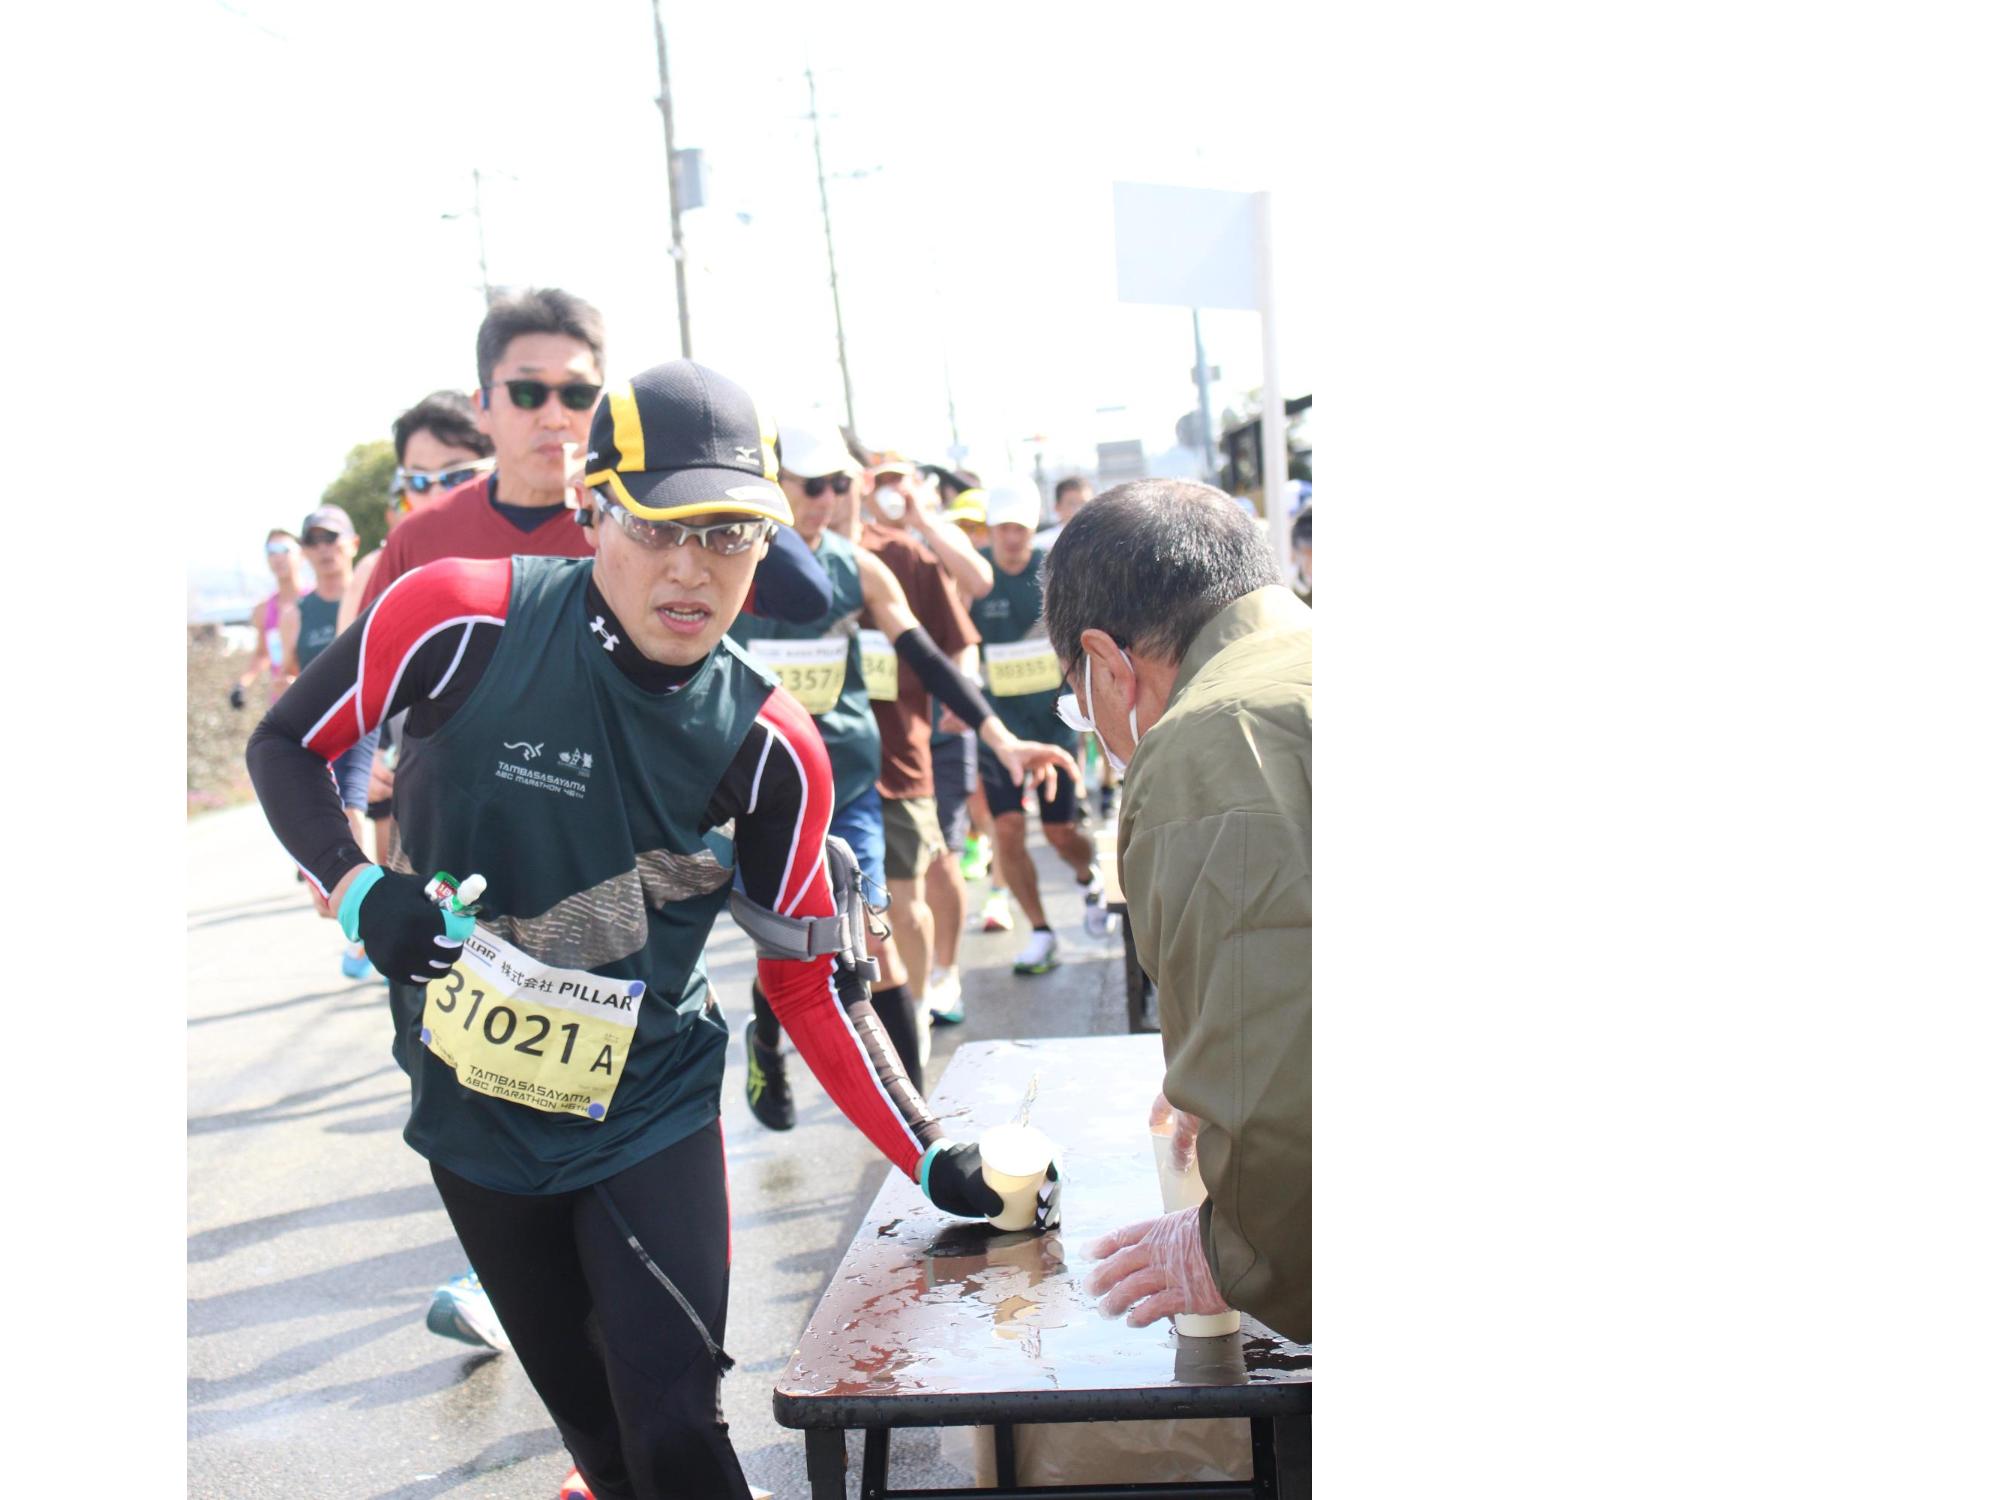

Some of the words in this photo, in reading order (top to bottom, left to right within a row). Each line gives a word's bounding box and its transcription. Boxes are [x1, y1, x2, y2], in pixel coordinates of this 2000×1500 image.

[775, 668, 832, 691] 357
[495, 770, 514, 781] ABC
[515, 775, 561, 793] MARATHON
[498, 761, 586, 792] TAMBASASAYAMA
[501, 961, 554, 993] 株式会社
[558, 981, 633, 1012] PILLAR
[436, 968, 580, 1064] 31021
[590, 1043, 613, 1075] A
[464, 1076, 489, 1091] ABC
[492, 1086, 558, 1110] MARATHON
[469, 1064, 591, 1104] TAMBASASAYAMA
